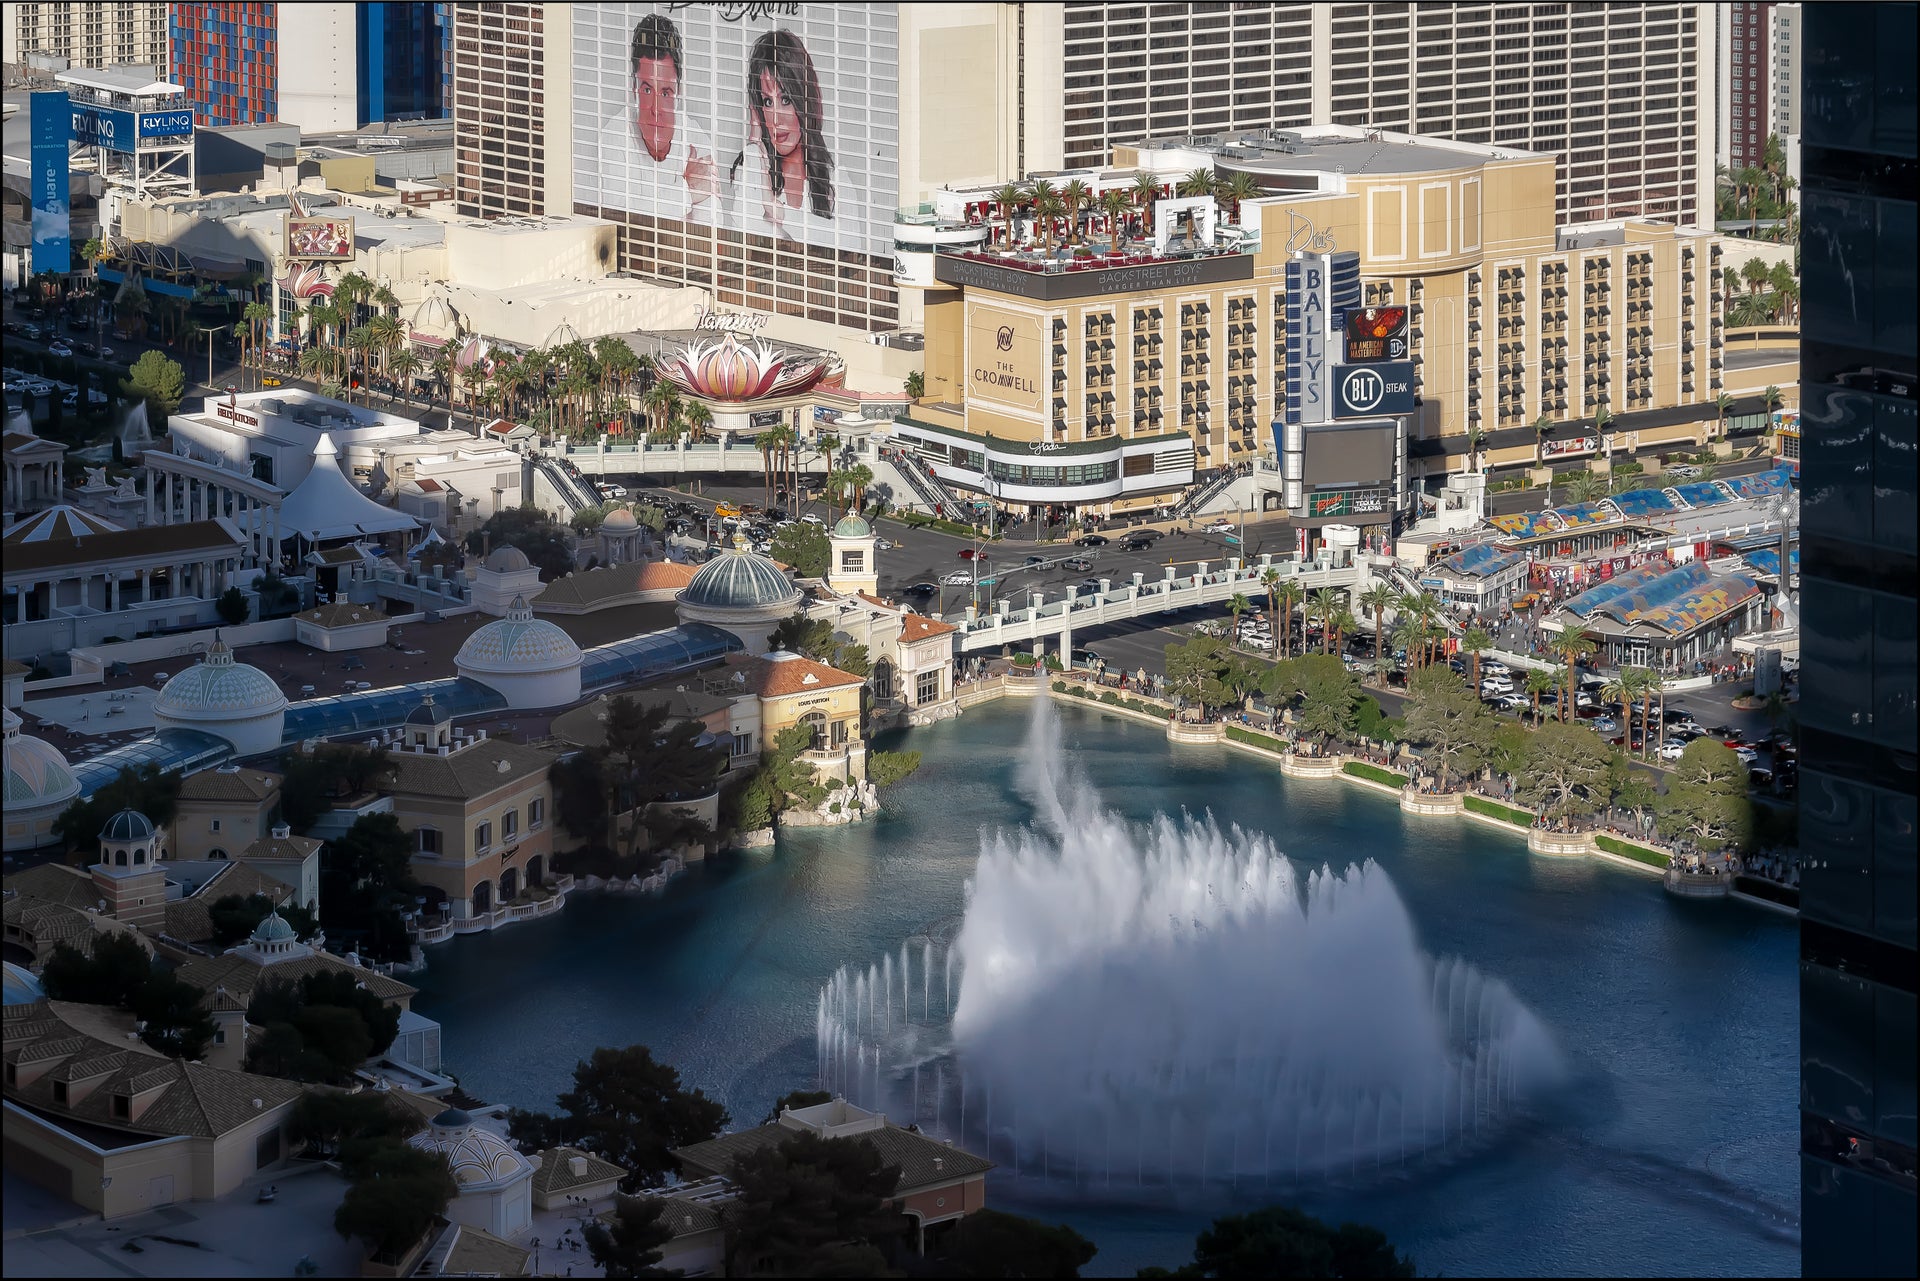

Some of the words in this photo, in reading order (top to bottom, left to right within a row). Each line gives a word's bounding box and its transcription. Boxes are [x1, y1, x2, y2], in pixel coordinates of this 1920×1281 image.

[72, 113, 114, 138] FLYLINQ
[143, 115, 190, 130] FLYLINQ
[953, 262, 1003, 281] BACKSTREET
[1006, 272, 1028, 286] BOYS
[1098, 266, 1169, 284] BACKSTREET
[1173, 263, 1202, 276] BOYS
[986, 280, 1006, 289] THAN
[1008, 285, 1025, 294] LIFE
[1101, 282, 1141, 292] LARGER
[1145, 278, 1172, 287] THAN
[1176, 276, 1197, 284] LIFE
[1303, 268, 1323, 404] BALLYS
[1350, 348, 1383, 358] MASTERPIECE
[1358, 340, 1384, 350] AMERICAN
[996, 361, 1014, 373] THE
[974, 368, 1036, 394] CROMWELL
[1352, 377, 1375, 402] BLT
[1385, 382, 1408, 393] STEAK
[234, 412, 258, 426] KITCHEN
